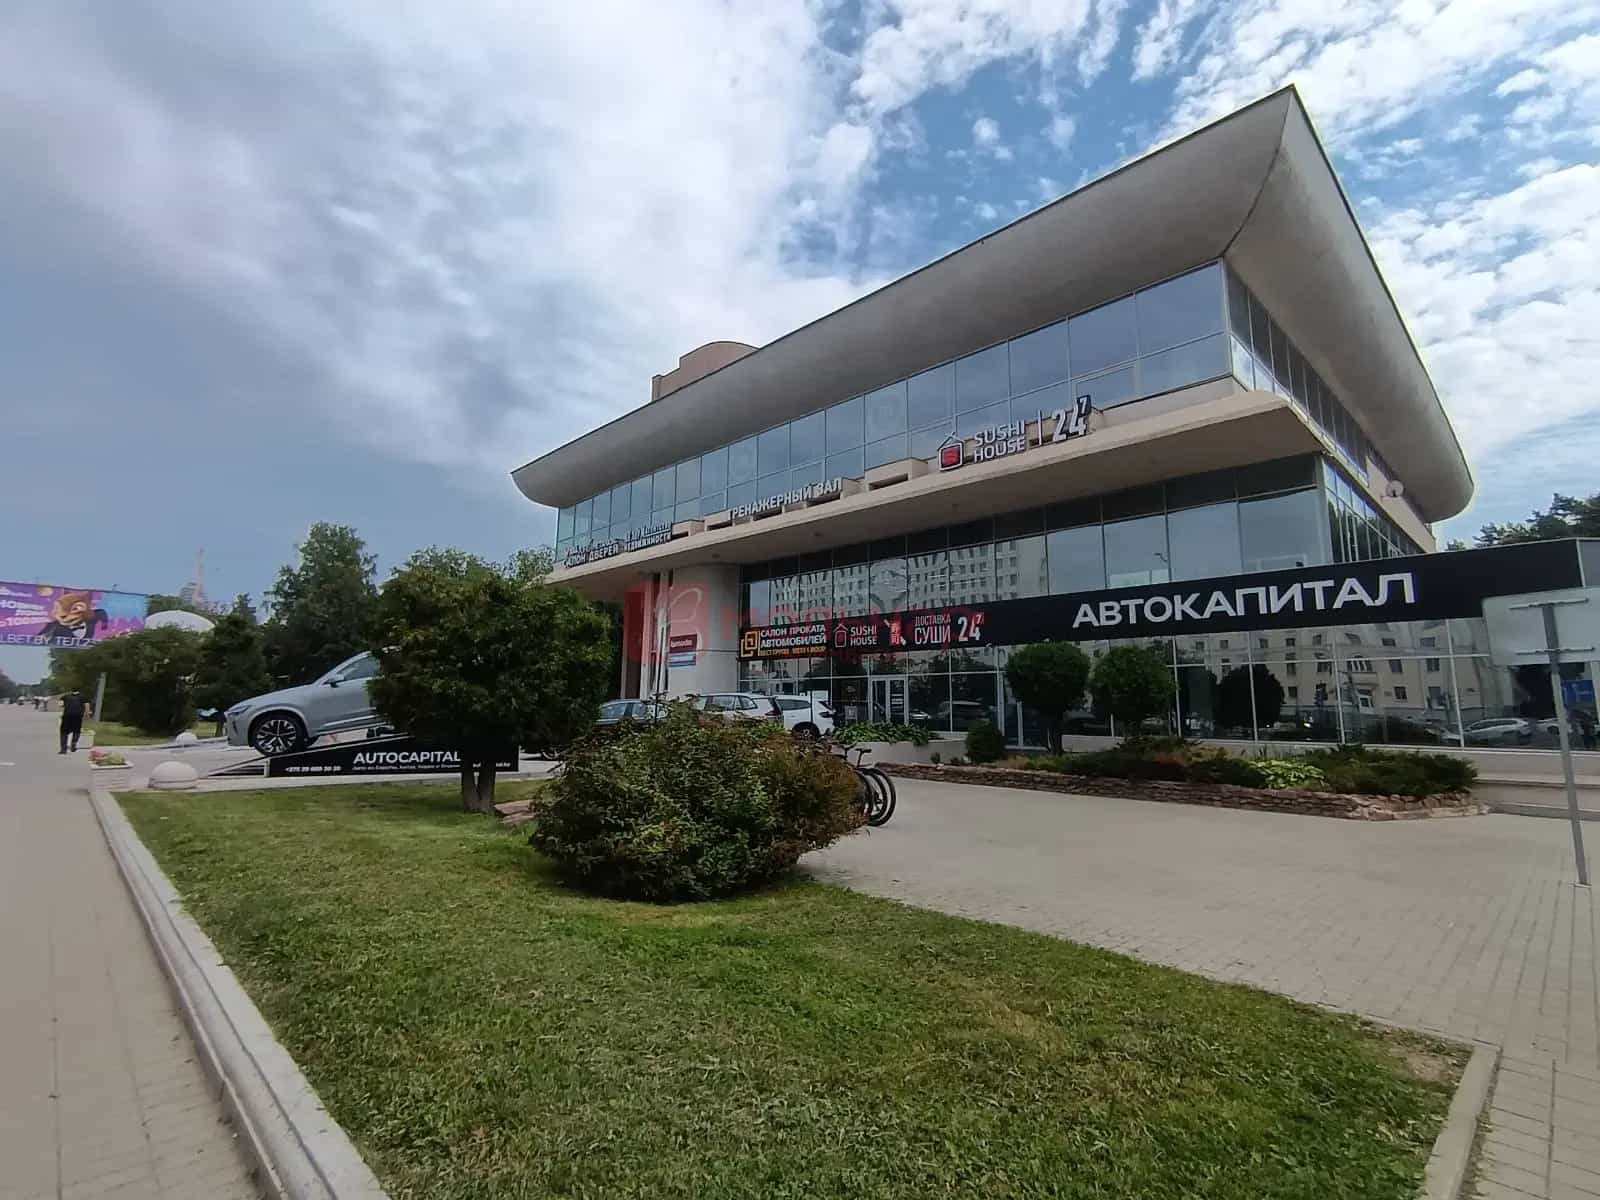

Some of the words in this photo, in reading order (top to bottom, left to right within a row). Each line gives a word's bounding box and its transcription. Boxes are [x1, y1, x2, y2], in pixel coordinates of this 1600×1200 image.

[974, 419, 1026, 447] SUSHI
[974, 437, 1026, 463] HOUSE
[727, 484, 813, 521] ТРЕНАЖЕРНЫЙ
[812, 477, 843, 500] ЗАЛ
[1072, 572, 1416, 629] АВТОКАПИТАЛ
[914, 613, 952, 627] ДОСТАВКА
[760, 629, 788, 638] САЛОН
[789, 624, 826, 636] ПРОКАТА
[849, 623, 878, 636] SUSHI
[913, 624, 952, 645] СУШИ
[760, 633, 827, 649] АВТОМОБИЛЕЙ
[850, 635, 878, 647] HOUSE
[352, 751, 461, 764] AUTOCAPITAL
